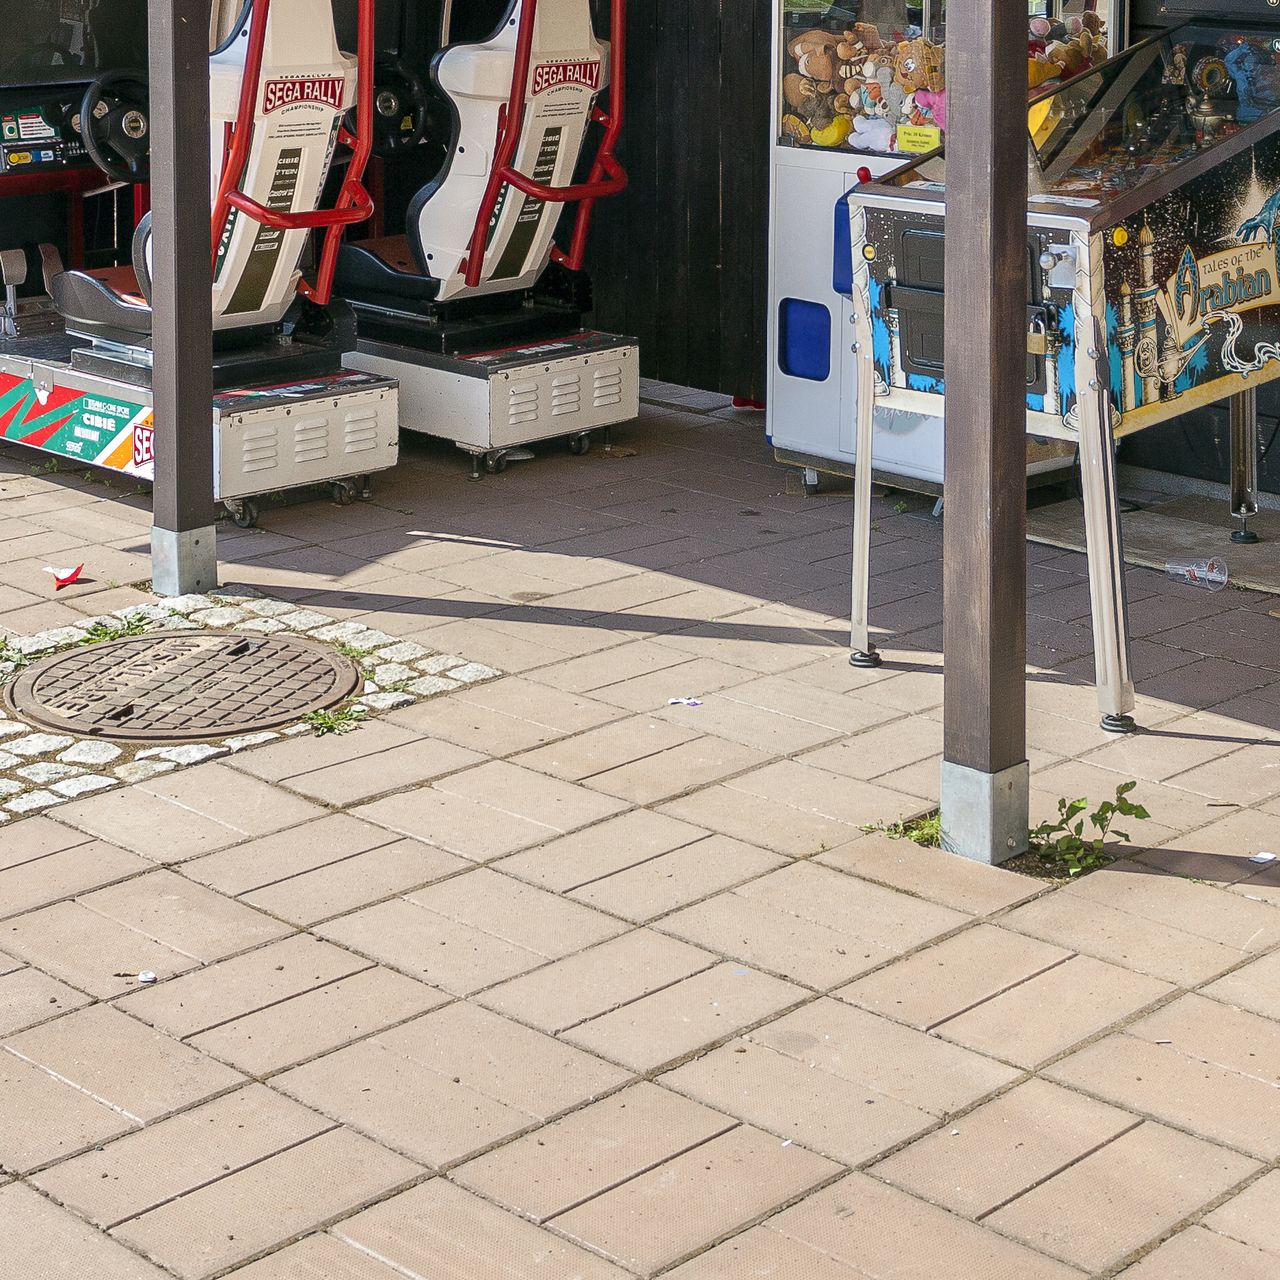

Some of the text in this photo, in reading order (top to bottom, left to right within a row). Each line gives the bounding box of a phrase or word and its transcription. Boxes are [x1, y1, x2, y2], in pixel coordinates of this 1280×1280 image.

[535, 63, 600, 92] SEGA RALLY
[266, 80, 344, 111] SEGA RALLY
[1202, 257, 1230, 275] TALES
[1230, 252, 1244, 269] OF
[1175, 244, 1272, 327] Arabian
[82, 413, 116, 432] CIBIE
